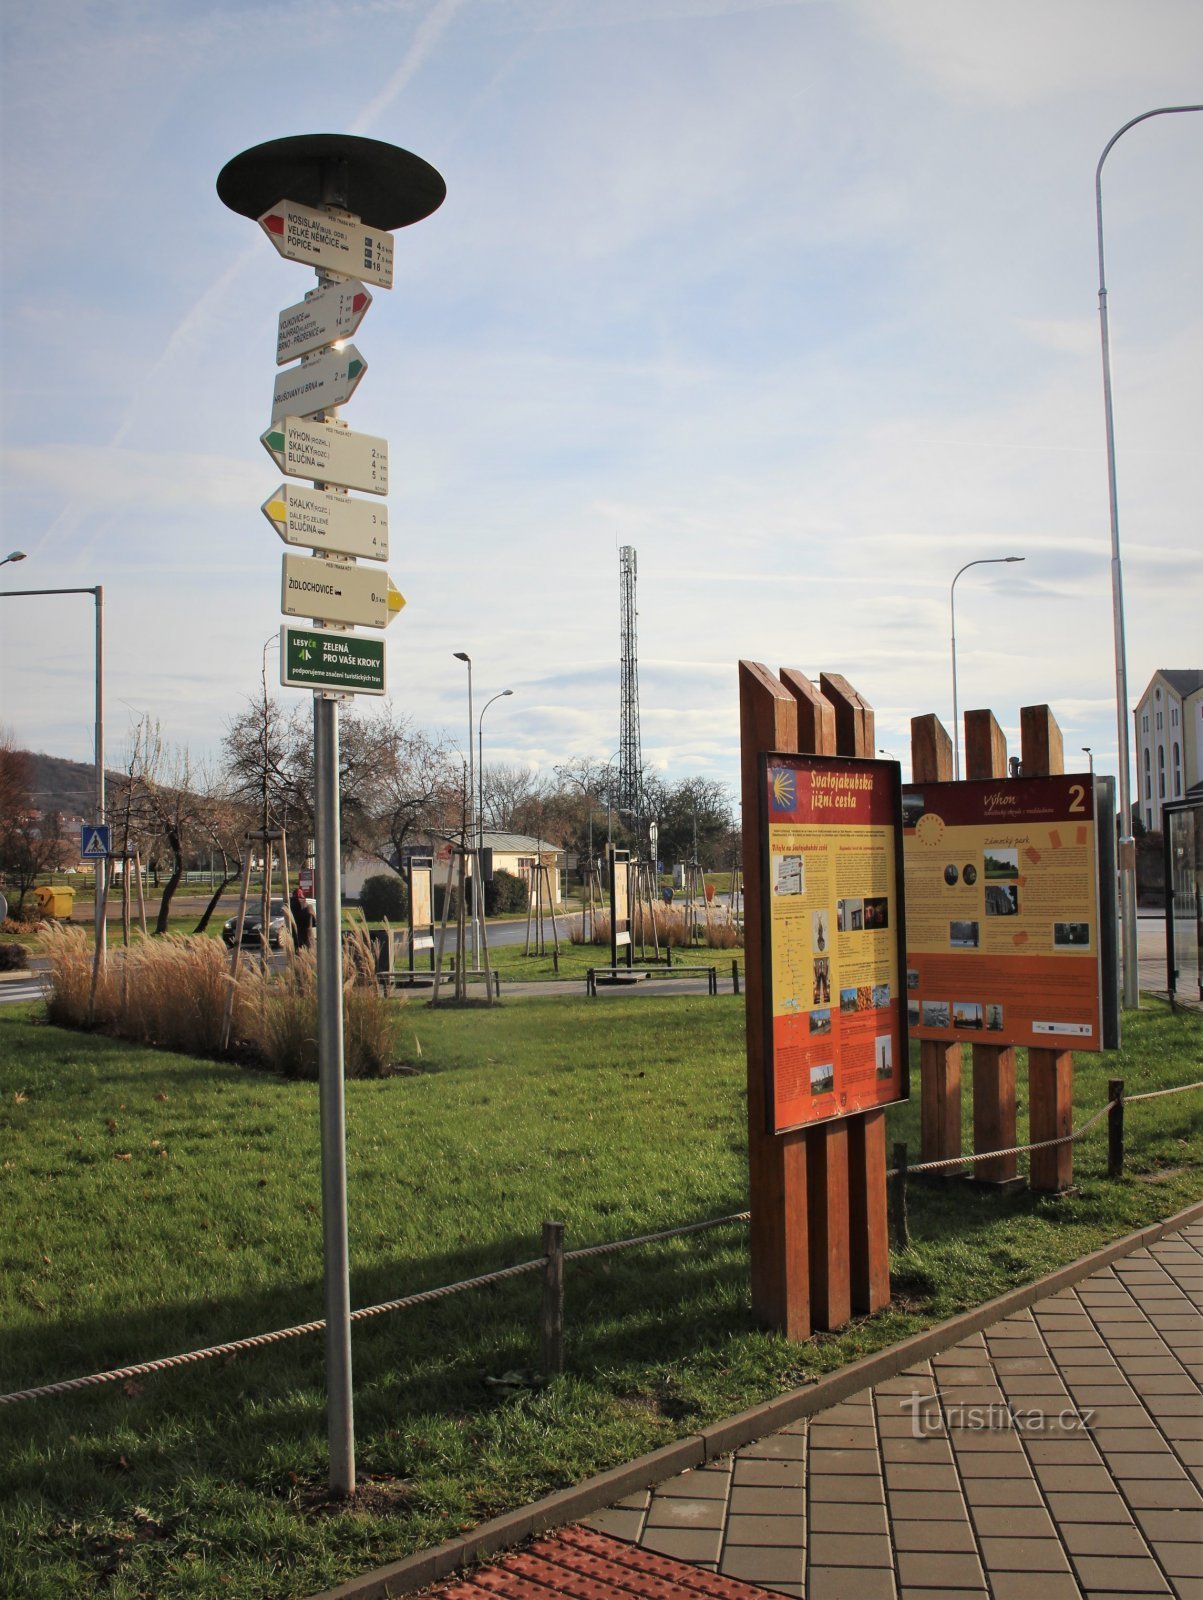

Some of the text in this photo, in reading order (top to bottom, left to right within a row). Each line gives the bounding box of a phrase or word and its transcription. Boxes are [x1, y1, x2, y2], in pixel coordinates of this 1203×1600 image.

[288, 213, 320, 231] NOSISLAV
[288, 225, 340, 248] VELKÉ NĚMČICE
[288, 235, 312, 251] POPICE
[373, 262, 381, 272] 18
[280, 312, 304, 330] VOJKOVICE
[278, 340, 290, 352] BRNO
[304, 381, 318, 393] BRNA
[288, 428, 311, 442] VÝHON
[288, 441, 314, 455] SKALKY
[288, 452, 316, 466] BLUČINA
[372, 460, 376, 469] 4
[372, 471, 376, 480] 5
[290, 498, 314, 511] SKALKY
[372, 515, 376, 524] 3
[290, 520, 317, 534] BLUČINA
[372, 537, 376, 546] 4
[289, 576, 334, 595] ŽIDLOCHOVICE
[323, 642, 350, 653] ZELENÁ
[323, 654, 380, 668] PRO VAŠE KROKY
[292, 668, 325, 676] podporujeme
[344, 672, 372, 682] turistických
[810, 770, 874, 792] Svatojakubská
[811, 791, 856, 810] jižní cesta
[984, 792, 1016, 812] Výhon
[1068, 784, 1086, 812] 2
